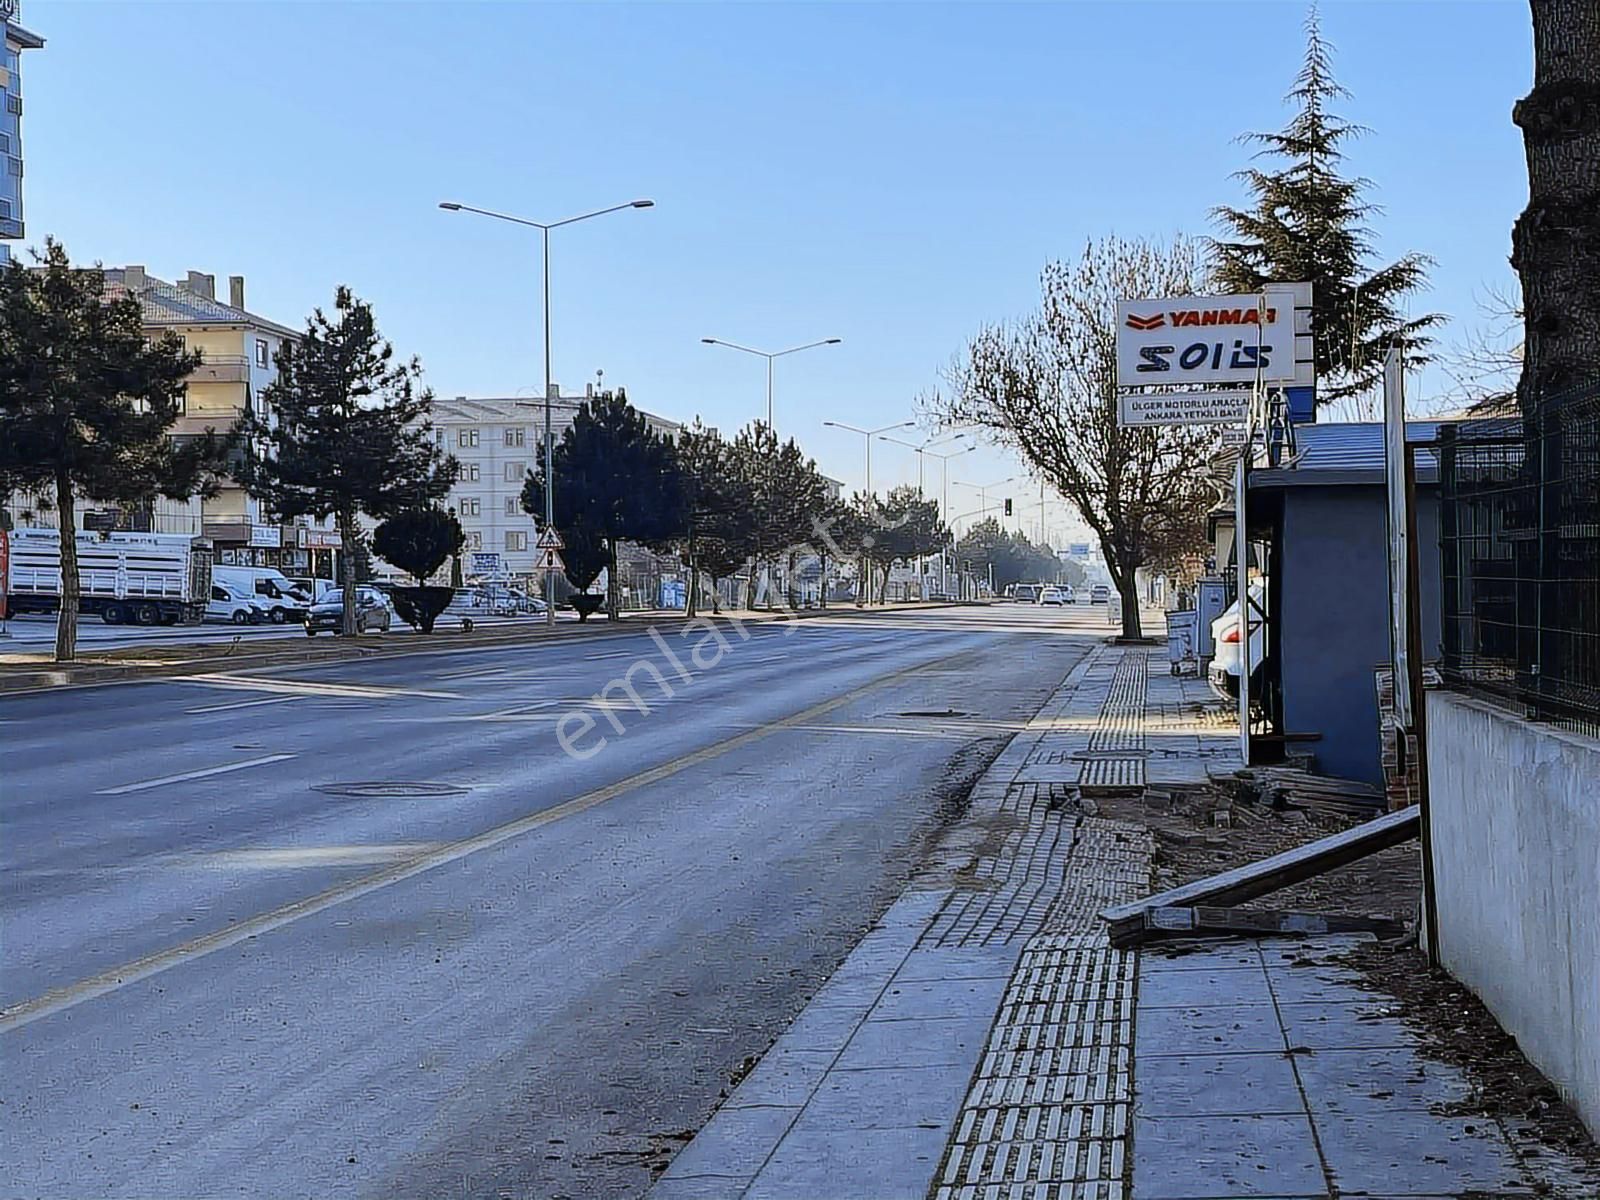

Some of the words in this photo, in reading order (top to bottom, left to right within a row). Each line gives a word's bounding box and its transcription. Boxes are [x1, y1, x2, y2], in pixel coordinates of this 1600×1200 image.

[1169, 308, 1277, 327] YANMAR
[1131, 401, 1163, 411] ÜLGER
[1165, 399, 1209, 409] MOTORLU
[1211, 398, 1250, 408] ARAÇLA
[1144, 411, 1182, 420] ANKARA
